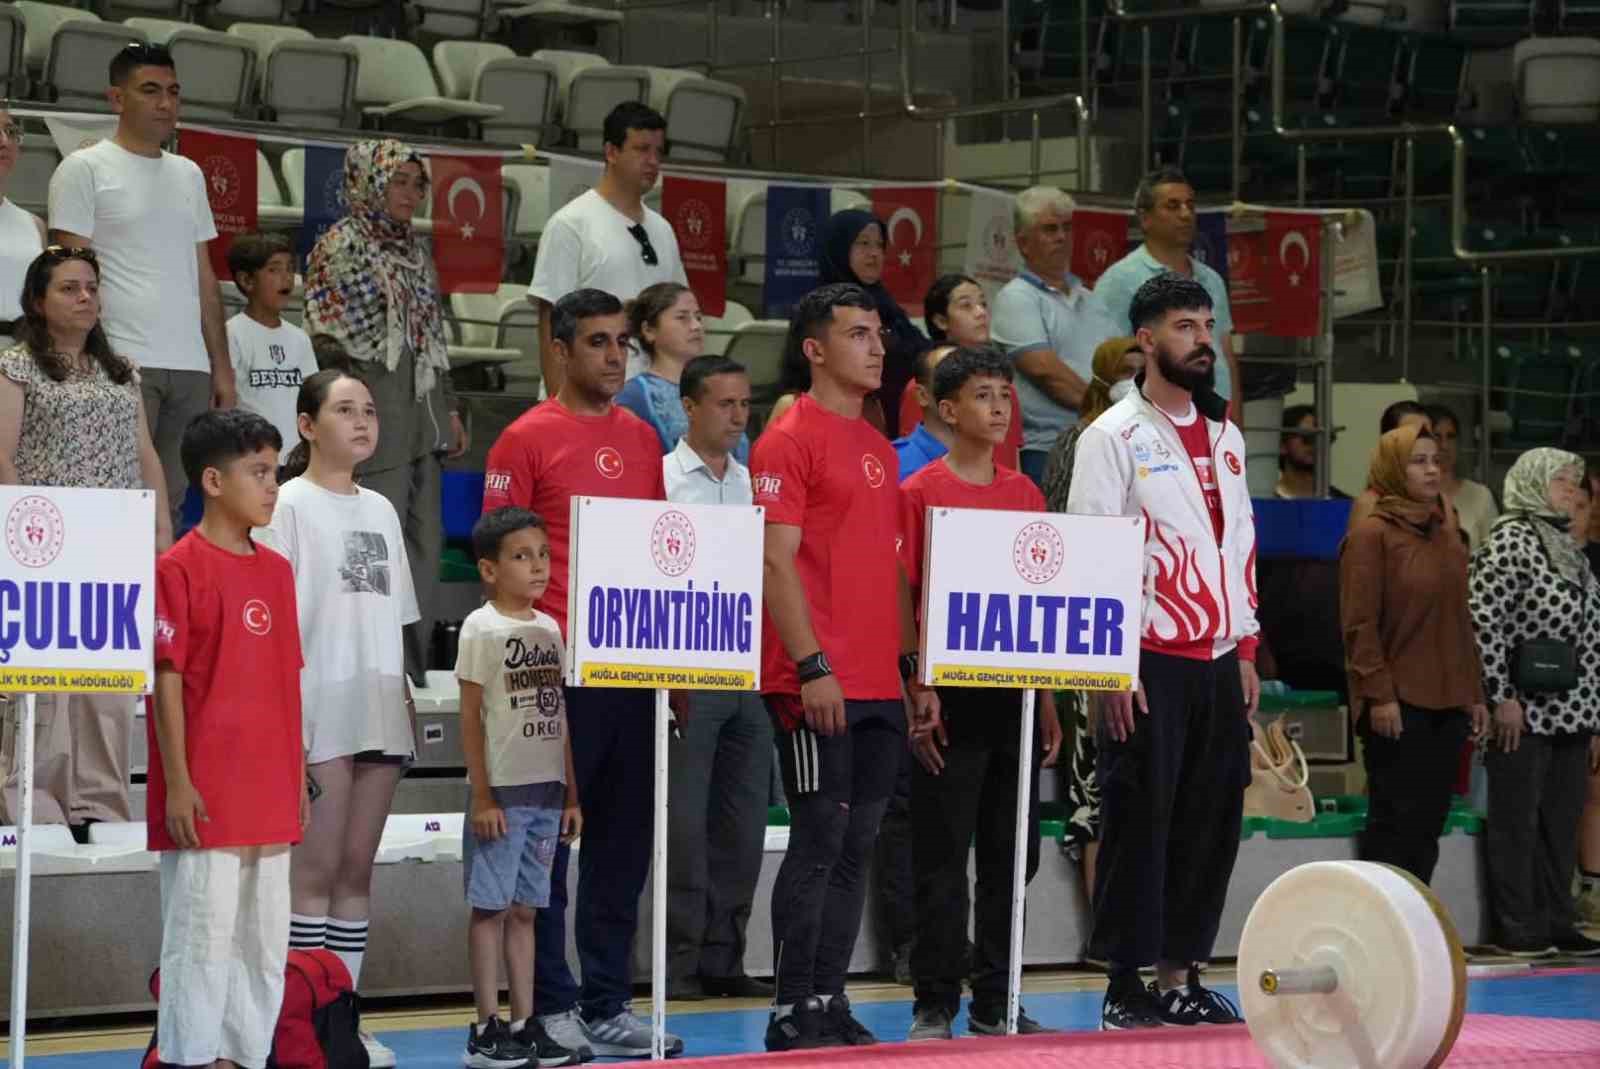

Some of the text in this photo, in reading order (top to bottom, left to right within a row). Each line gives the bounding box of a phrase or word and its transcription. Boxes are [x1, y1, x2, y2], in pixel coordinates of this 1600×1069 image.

[588, 580, 752, 653] ORYANTİRİNG
[946, 591, 1125, 656] HALTER
[16, 674, 28, 686] VE
[31, 675, 57, 686] SPOR
[59, 673, 68, 687] İL
[71, 674, 134, 688] MÜDÜRLÜĞÜ
[590, 668, 745, 687] MUĞLA GENÇLİK VE SPOR İL MÜDÜRLÜĞÜ
[942, 669, 1120, 689] MUĞLA GENÇLİK VE SPOR İL MÜDÜRLÜĞÜ
